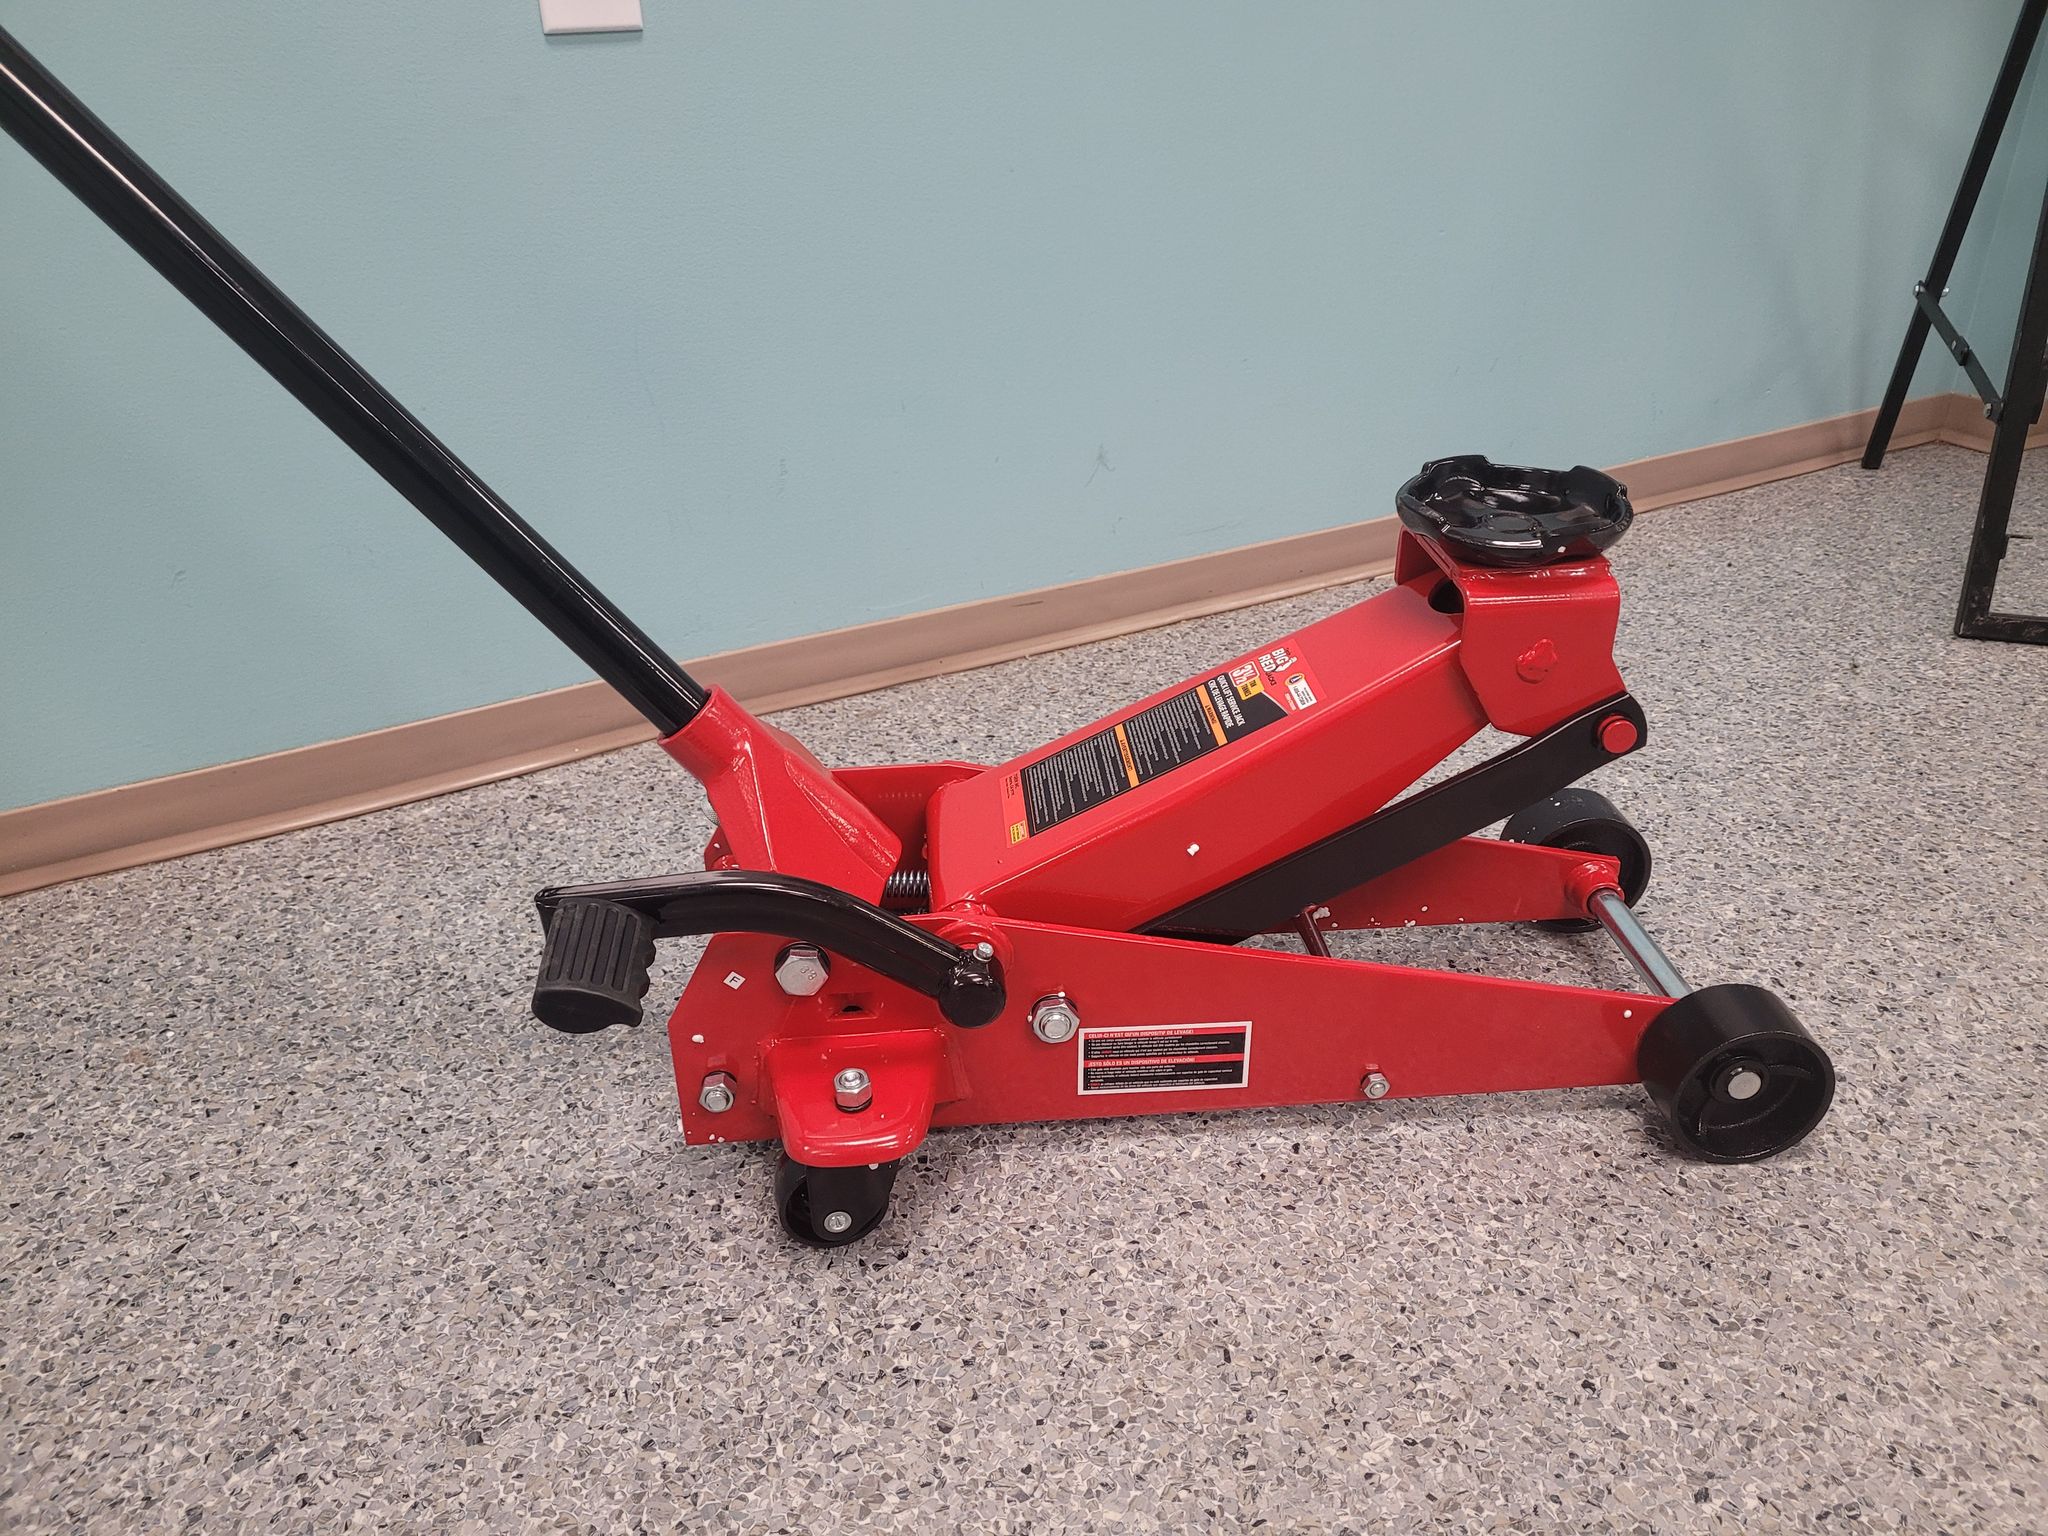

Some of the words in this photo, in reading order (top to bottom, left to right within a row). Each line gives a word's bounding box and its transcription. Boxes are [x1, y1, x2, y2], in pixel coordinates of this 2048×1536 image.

[1258, 653, 1277, 672] RED
[1272, 648, 1289, 665] BIG
[1208, 679, 1217, 690] CRIC
[1217, 675, 1228, 689] QUICK
[1212, 688, 1220, 697] DE
[1222, 687, 1232, 697] LIFT
[1214, 695, 1227, 712] LEVAGE
[1227, 696, 1240, 715] SERVICE
[1221, 710, 1234, 728] RAPIDE
[1234, 712, 1245, 726] JACK
